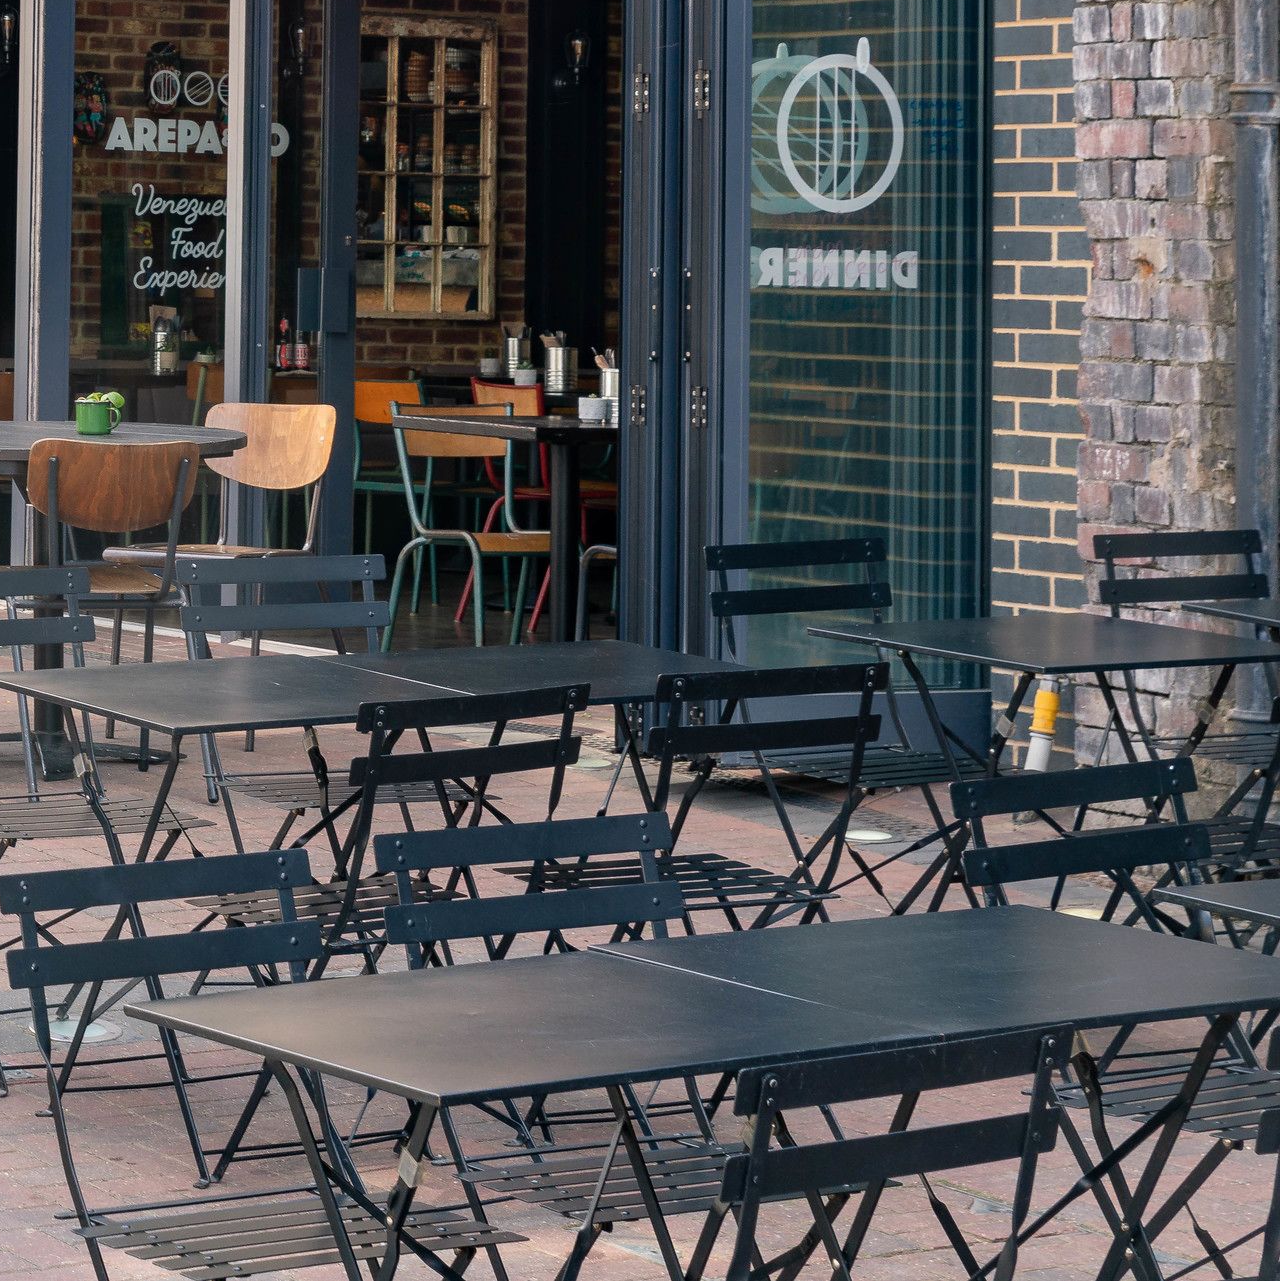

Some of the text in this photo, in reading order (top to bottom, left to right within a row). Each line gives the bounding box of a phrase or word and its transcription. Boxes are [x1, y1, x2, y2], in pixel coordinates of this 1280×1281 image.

[104, 116, 290, 157] AREPAO
[131, 182, 227, 225] Venezue
[170, 227, 225, 260] Food
[133, 256, 227, 297] Experie
